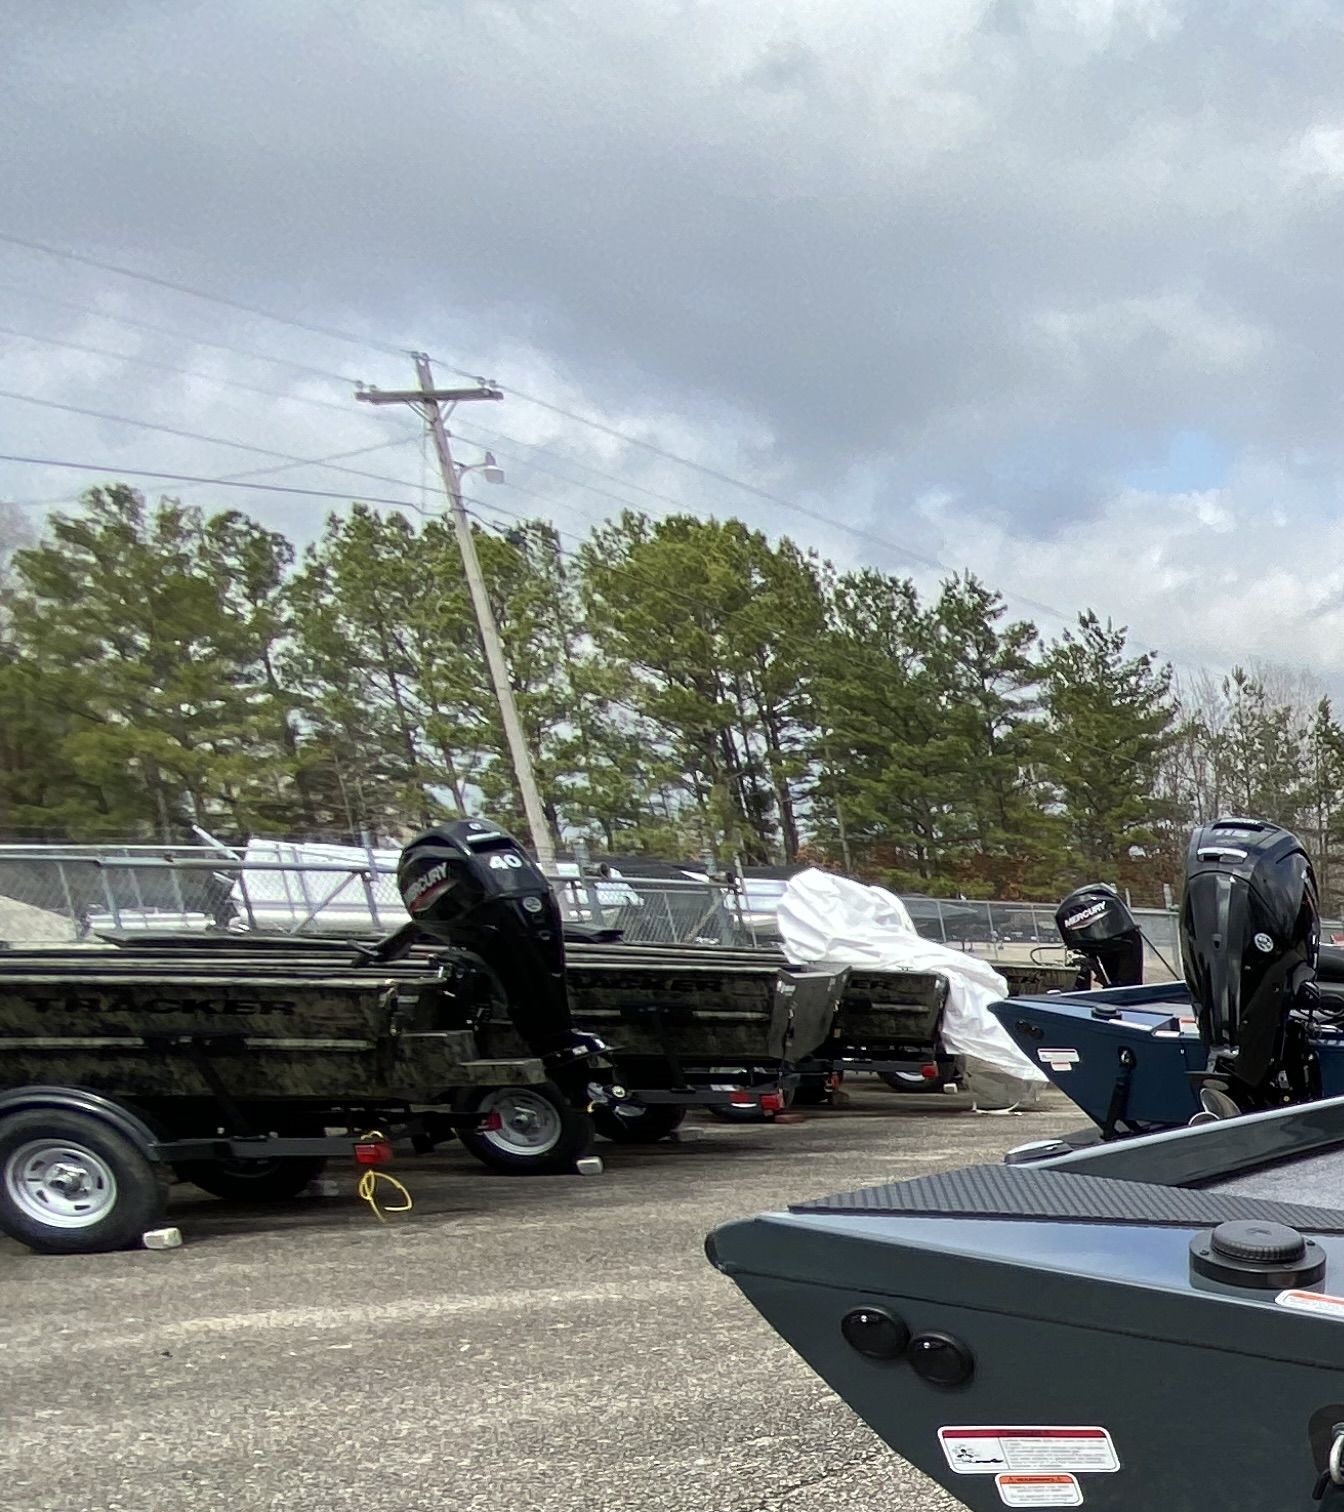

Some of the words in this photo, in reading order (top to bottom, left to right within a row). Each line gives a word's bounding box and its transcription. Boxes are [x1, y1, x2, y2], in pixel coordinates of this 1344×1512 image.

[489, 854, 523, 869] 40
[1064, 900, 1106, 929] MERCURY
[30, 996, 298, 1016] TRACKER
